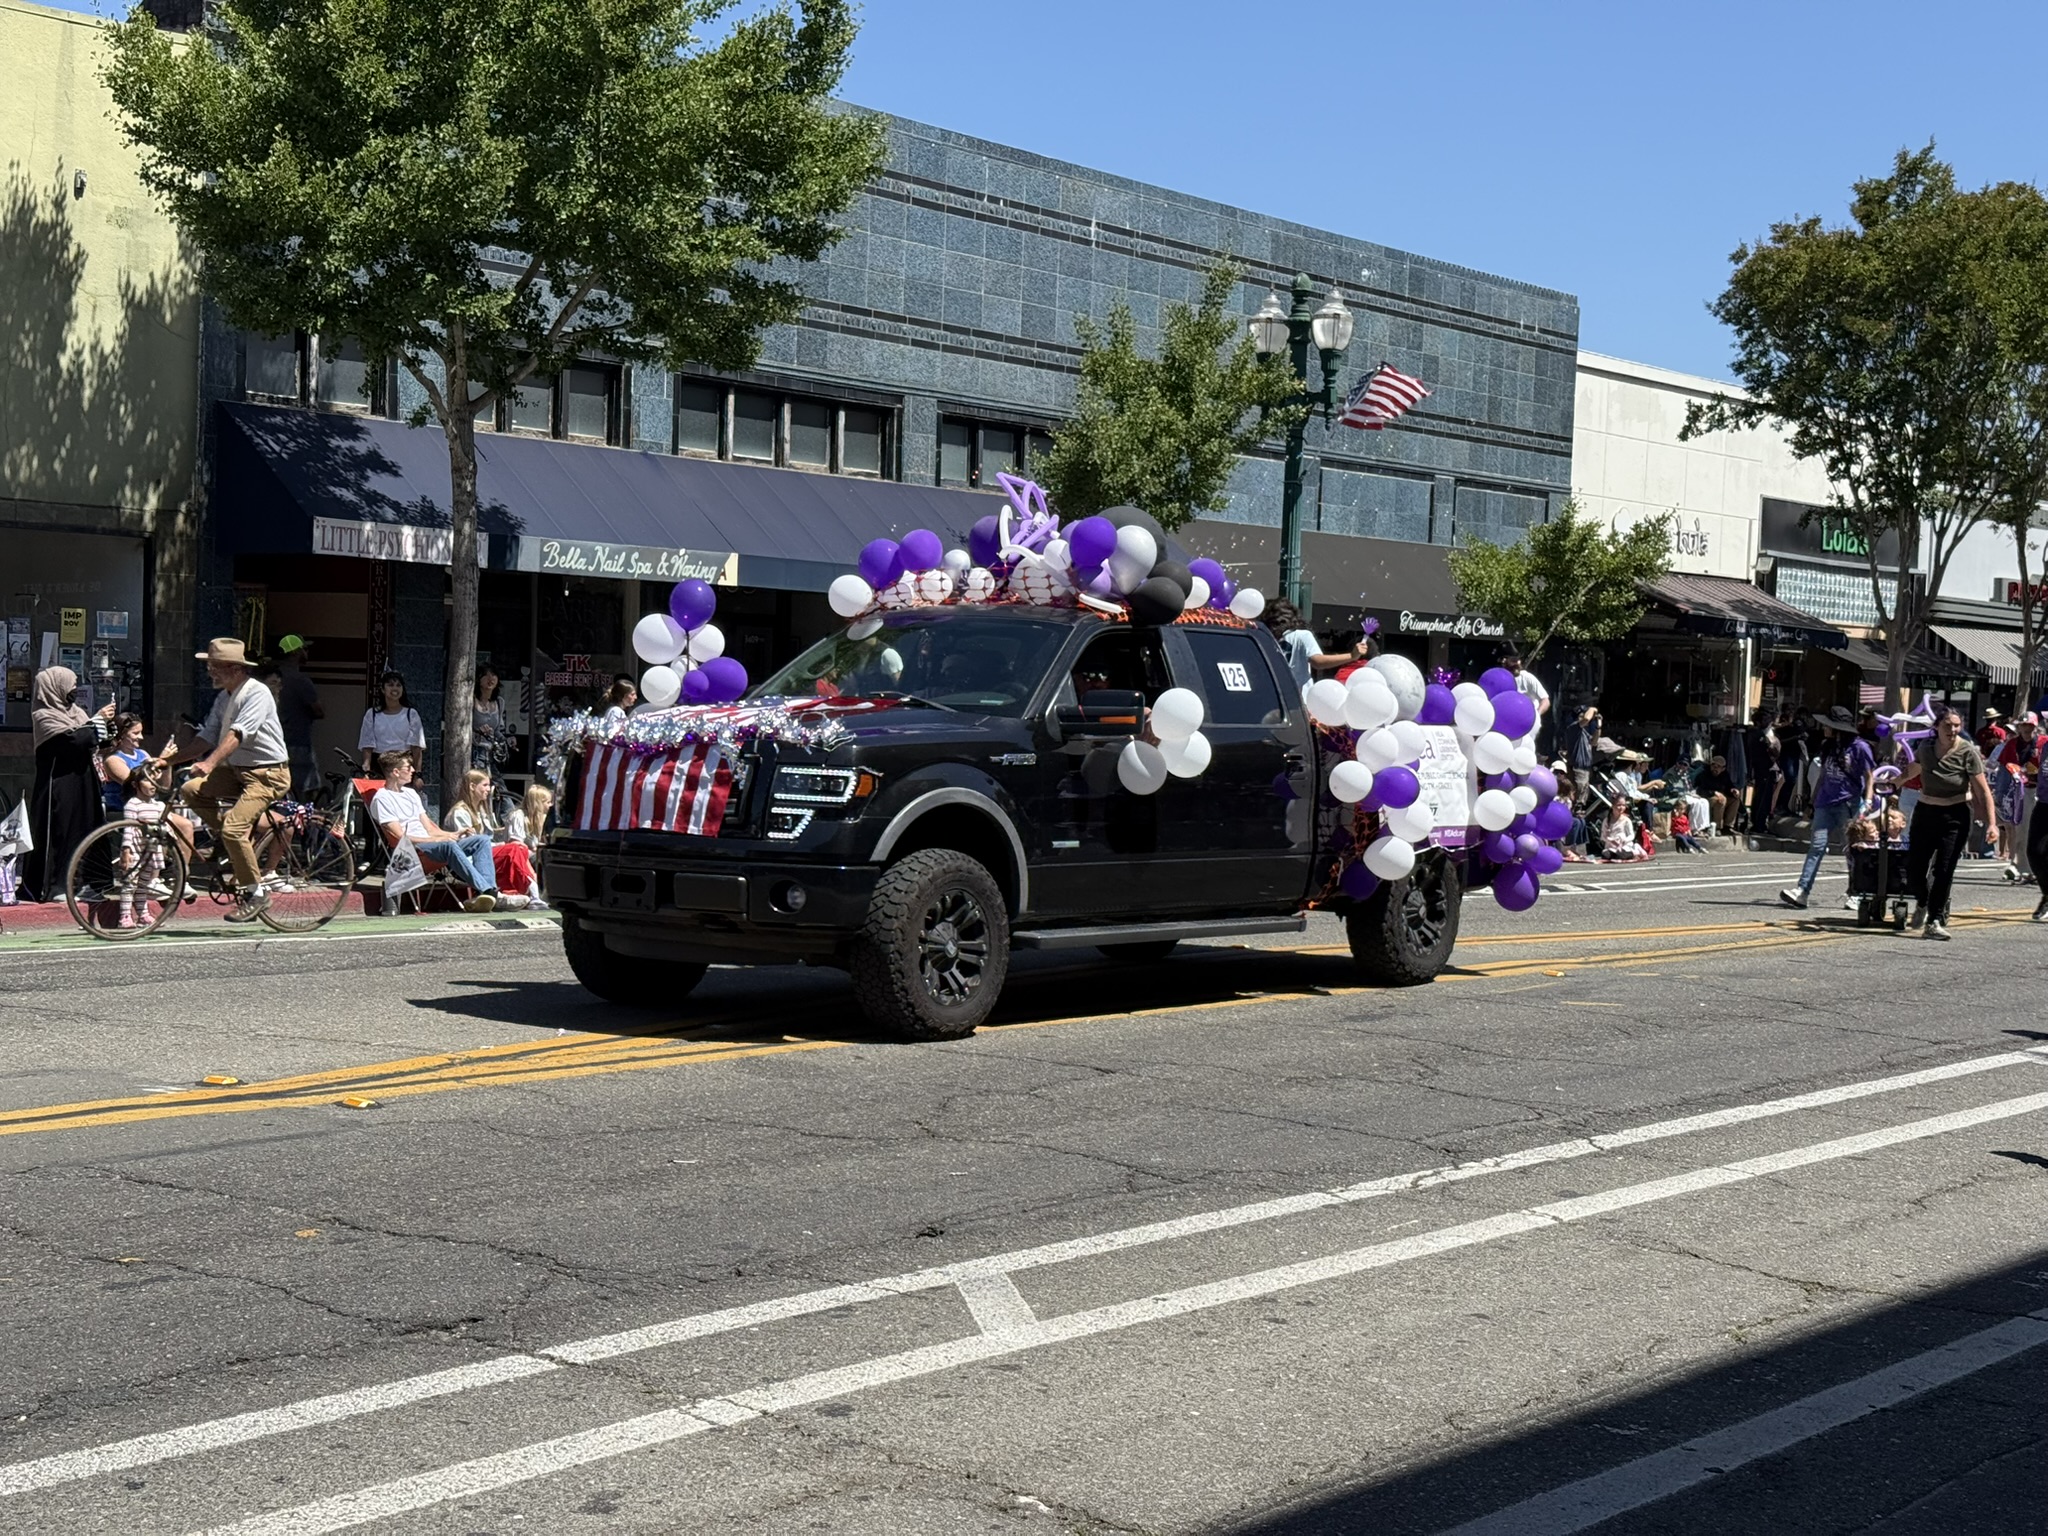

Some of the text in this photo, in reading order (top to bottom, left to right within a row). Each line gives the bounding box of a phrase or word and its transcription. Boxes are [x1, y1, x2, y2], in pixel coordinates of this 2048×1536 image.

[320, 525, 374, 556] LITTLE
[543, 542, 718, 583] Bella Nail Spa & Waxing
[374, 560, 384, 621] RTUNE
[63, 611, 82, 619] IMP
[1400, 610, 1504, 638] Triumphant Life Church
[562, 654, 591, 672] TK
[544, 672, 573, 686] BARBER
[574, 673, 593, 687] SHOP
[1222, 667, 1247, 687] 125
